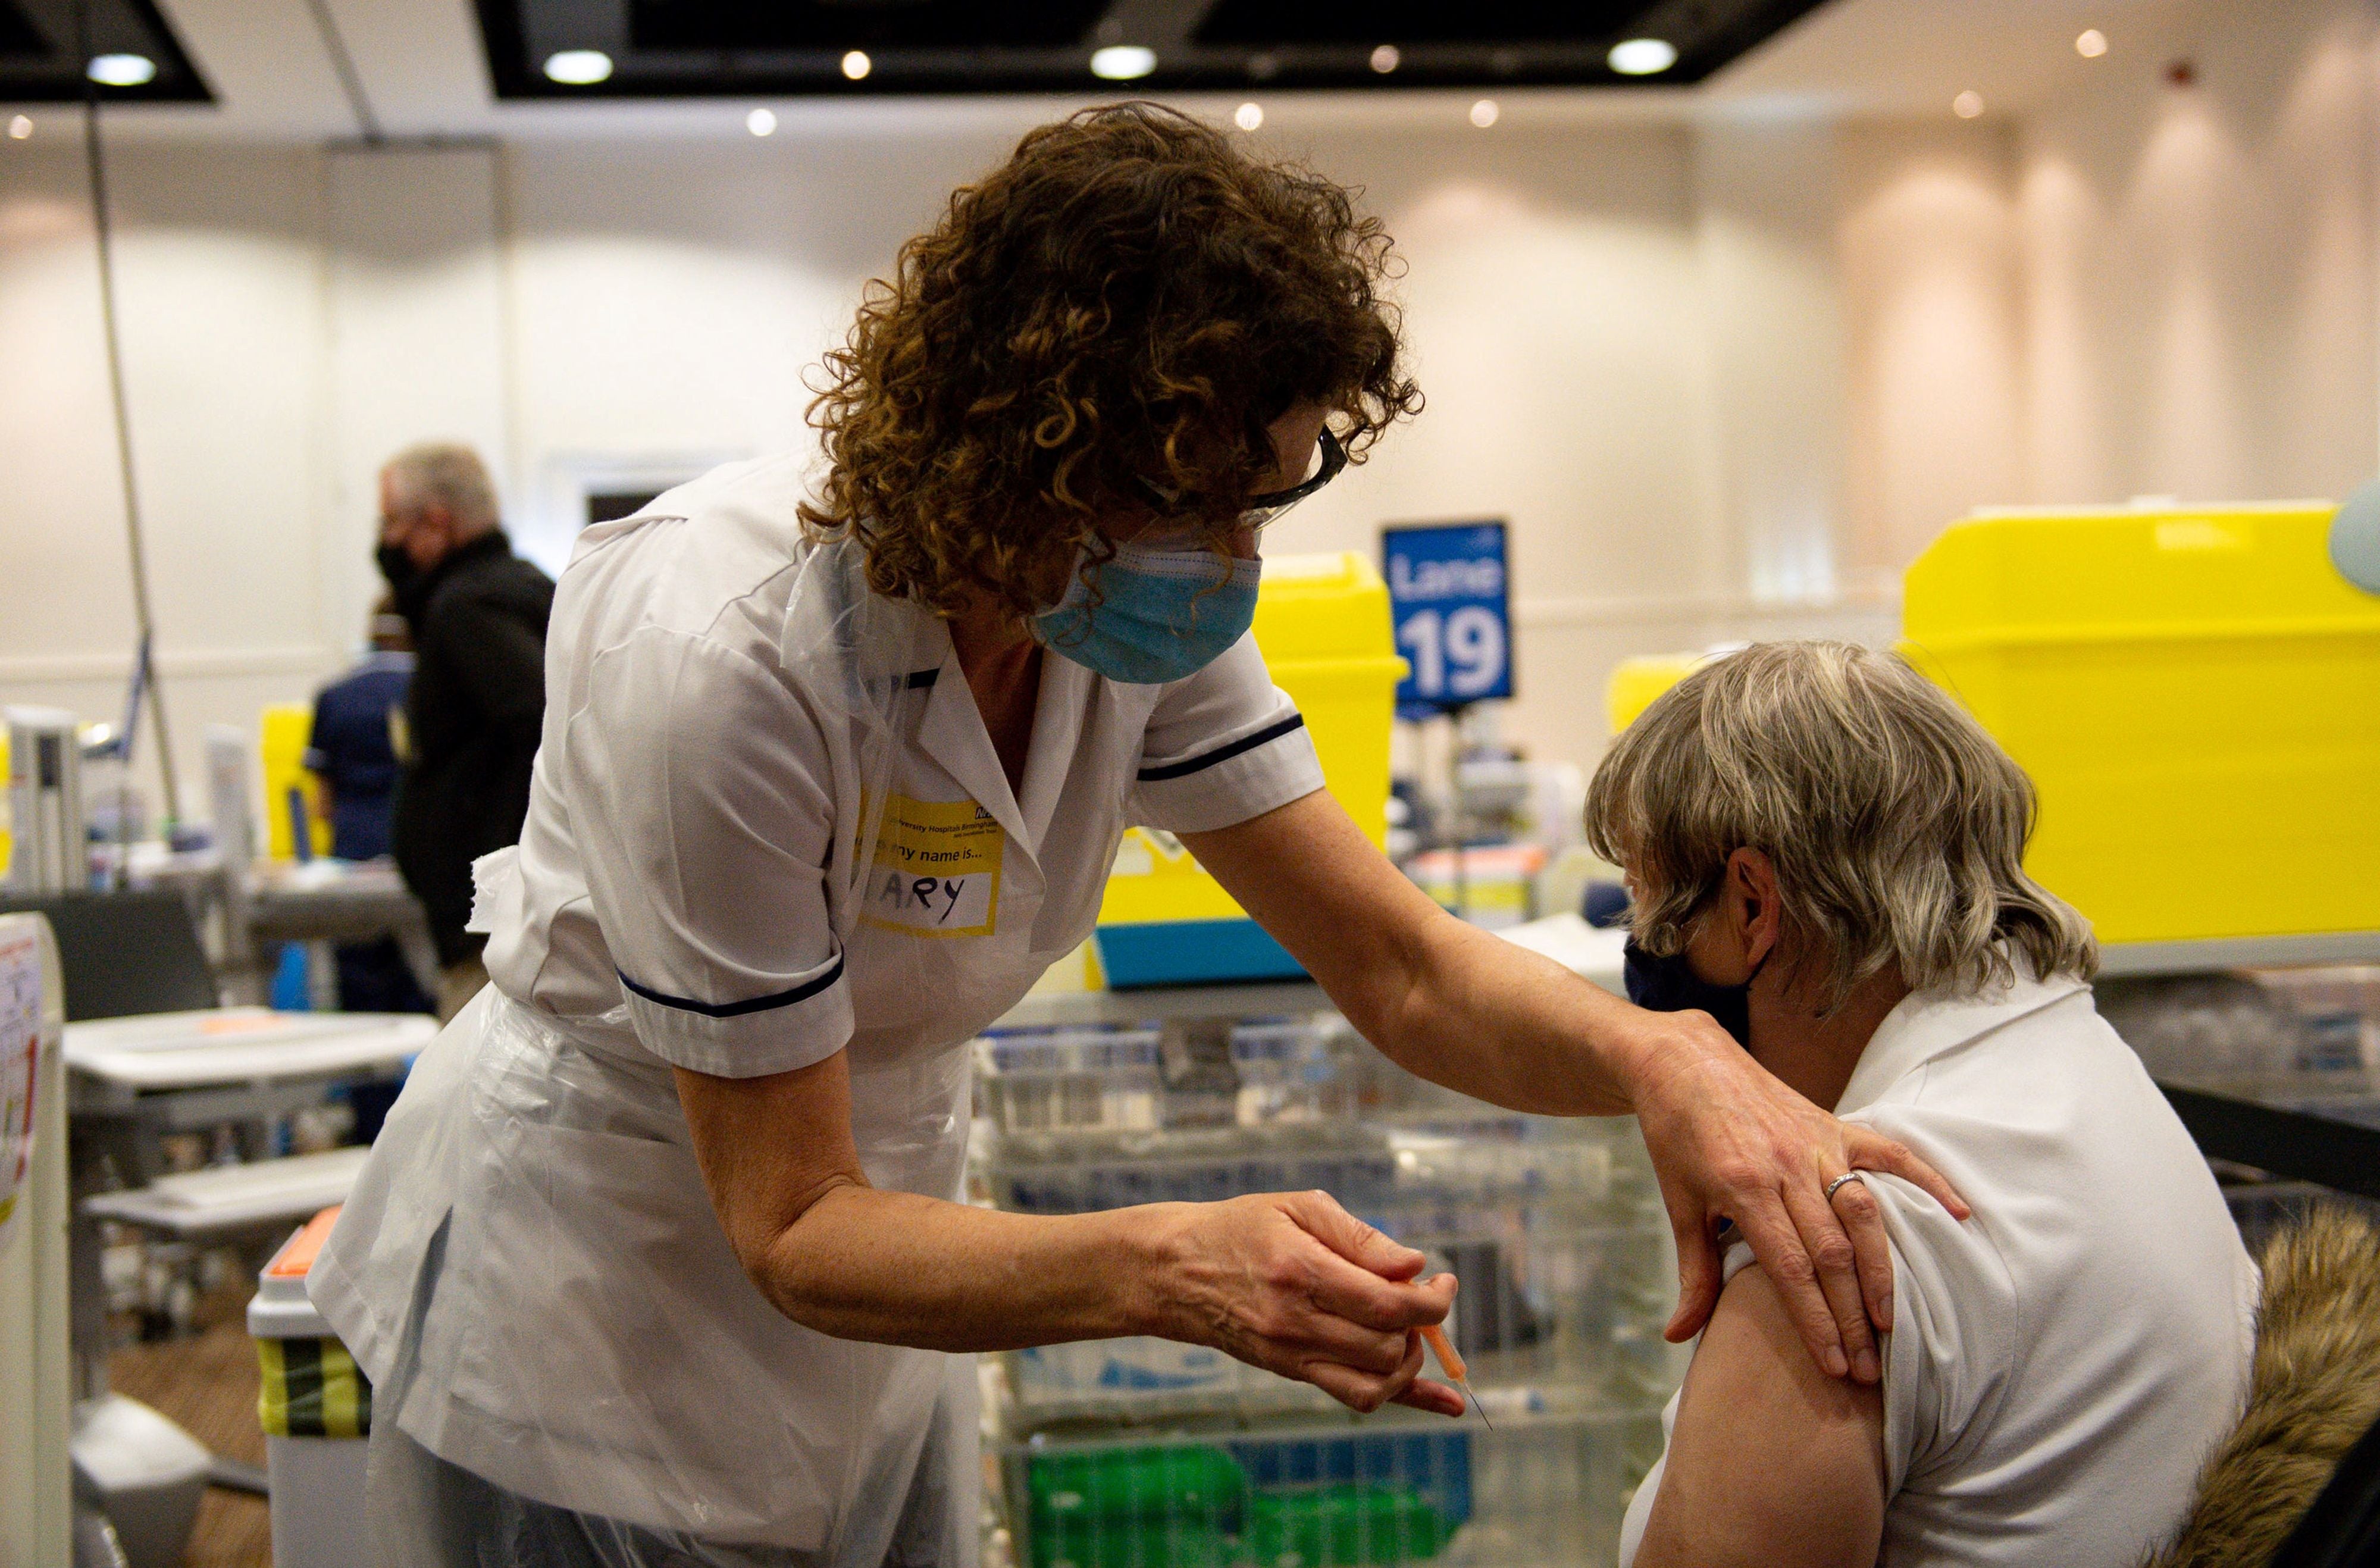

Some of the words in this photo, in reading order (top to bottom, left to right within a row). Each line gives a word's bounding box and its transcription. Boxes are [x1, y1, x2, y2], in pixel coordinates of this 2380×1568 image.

[1390, 554, 1504, 601] Lane
[1399, 605, 1506, 697] 19
[888, 816, 926, 832] iversity
[928, 825, 960, 833] Hospitals
[962, 821, 998, 831] Birmingham
[920, 851, 959, 862] name
[962, 847, 982, 860] is...
